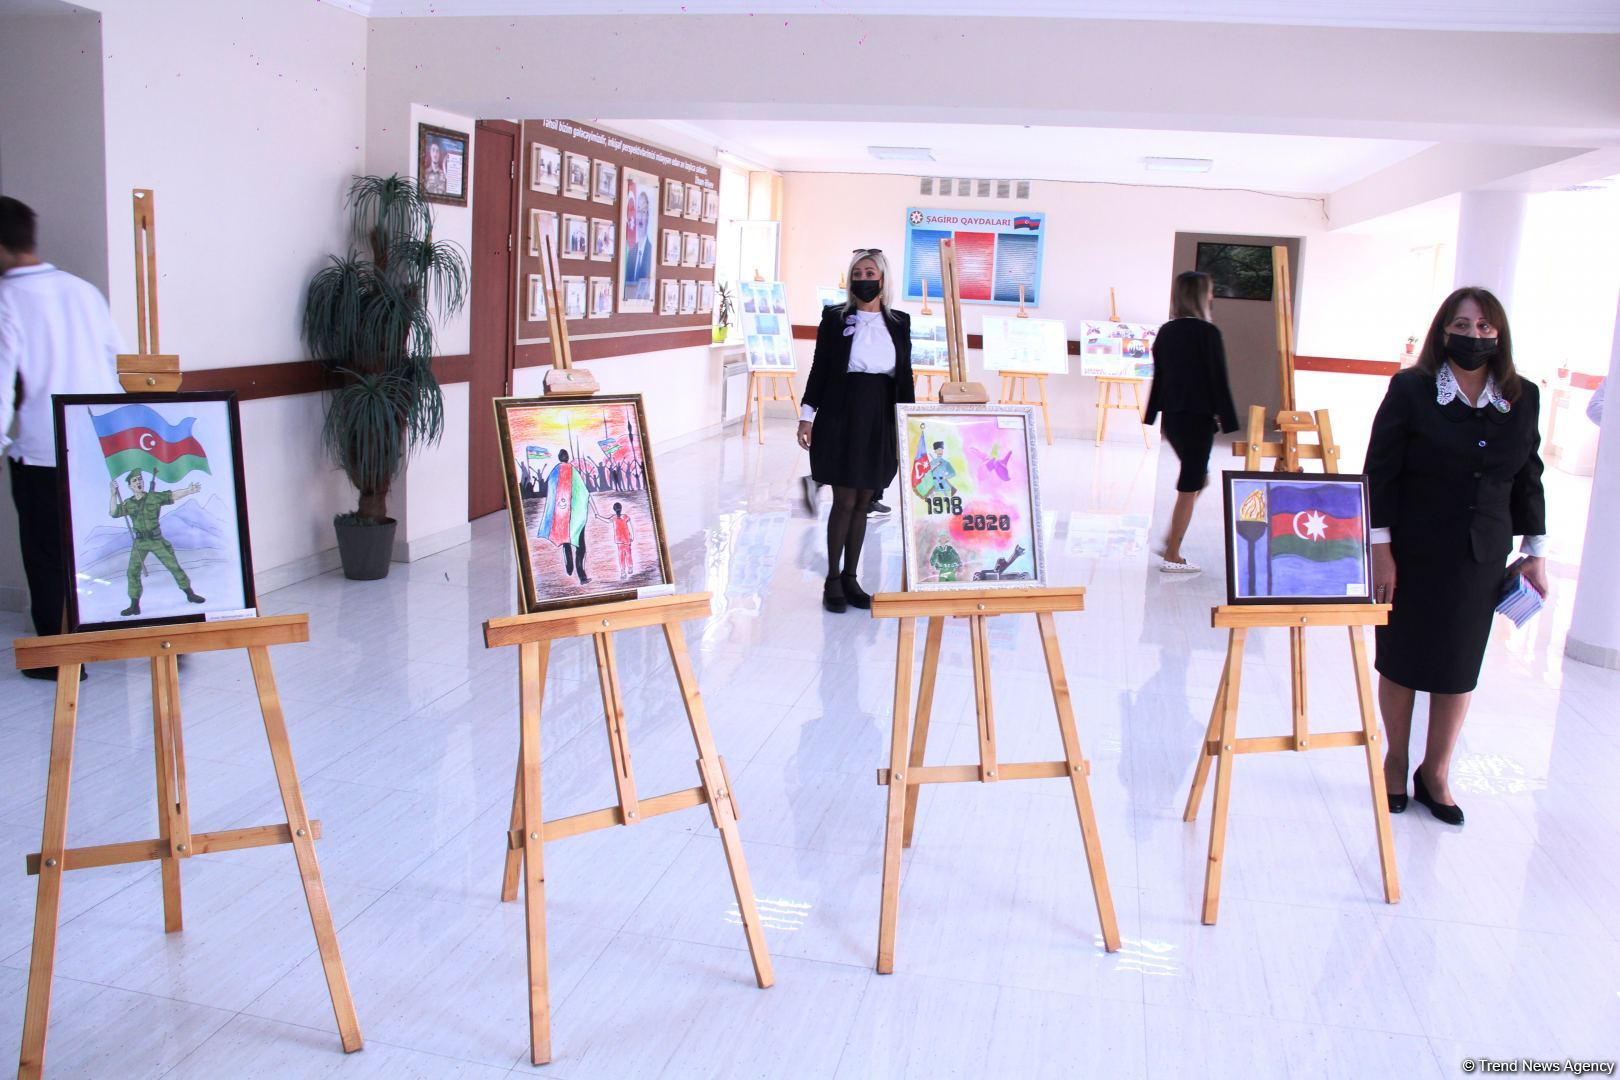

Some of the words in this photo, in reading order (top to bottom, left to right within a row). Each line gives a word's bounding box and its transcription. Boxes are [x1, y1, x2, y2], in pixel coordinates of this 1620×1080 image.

[961, 217, 1011, 226] QAYDALARI
[925, 496, 963, 515] 1918
[963, 514, 1011, 531] 2020
